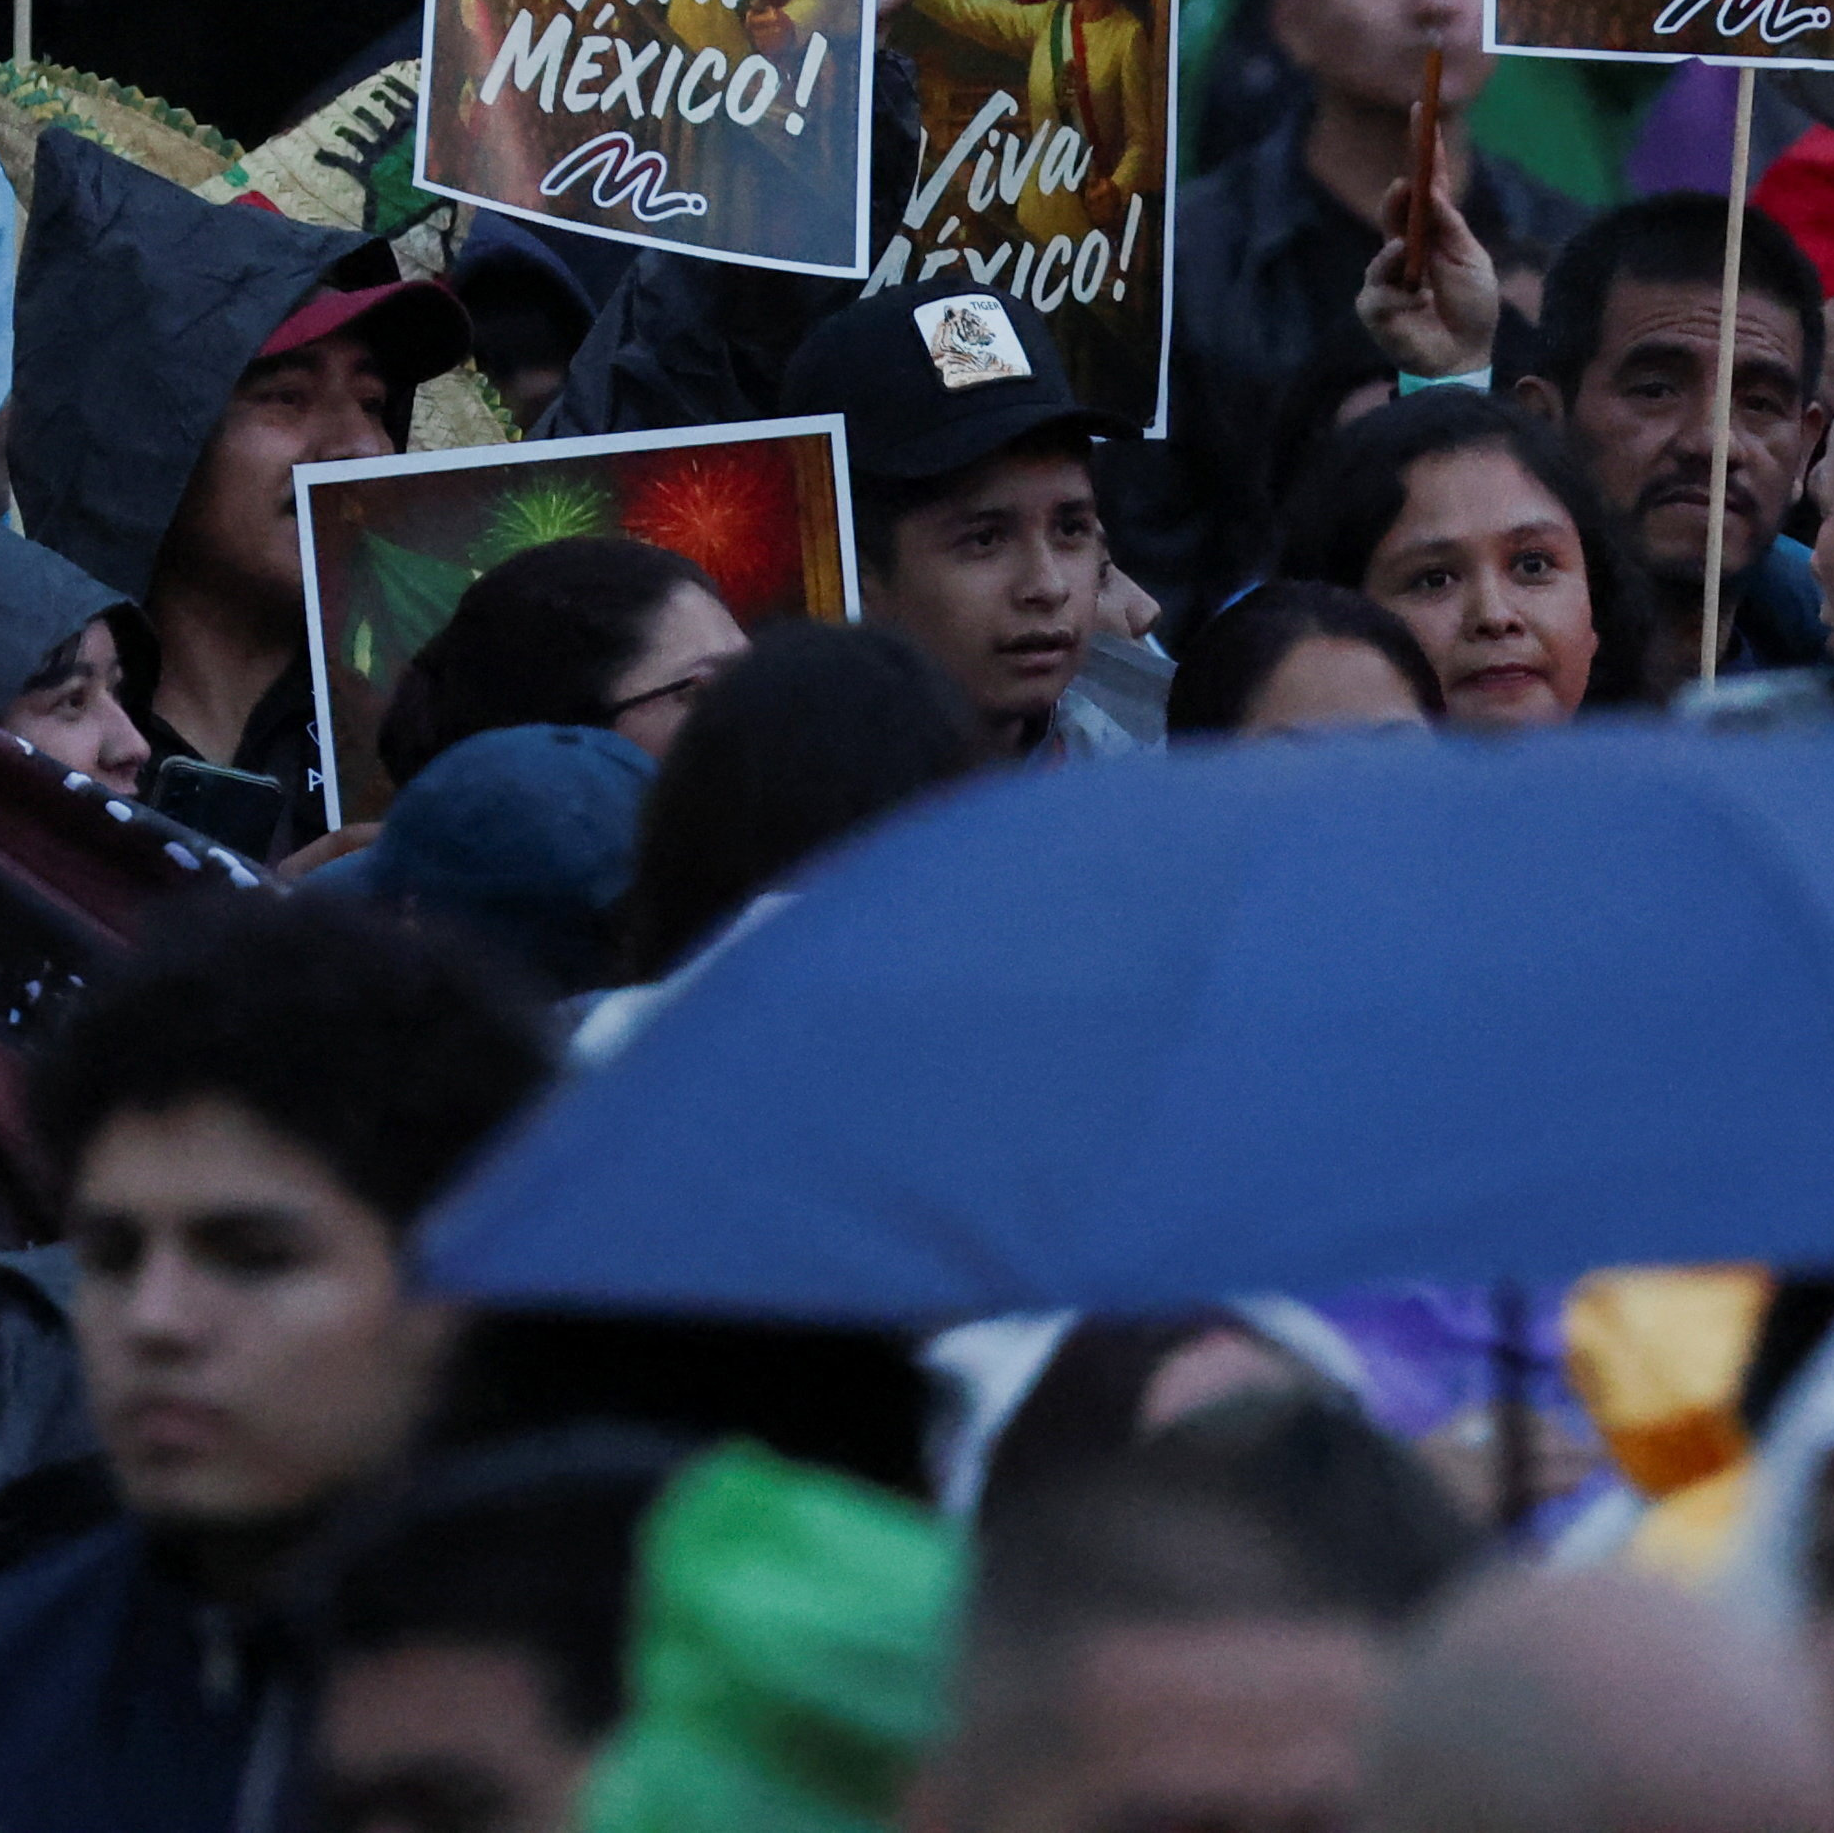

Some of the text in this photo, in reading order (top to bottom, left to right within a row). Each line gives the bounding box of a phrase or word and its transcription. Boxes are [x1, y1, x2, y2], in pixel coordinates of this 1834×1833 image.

[480, 1, 824, 135] MÉXICO!
[904, 89, 1093, 230] Viva
[969, 300, 1001, 313] TIGER
